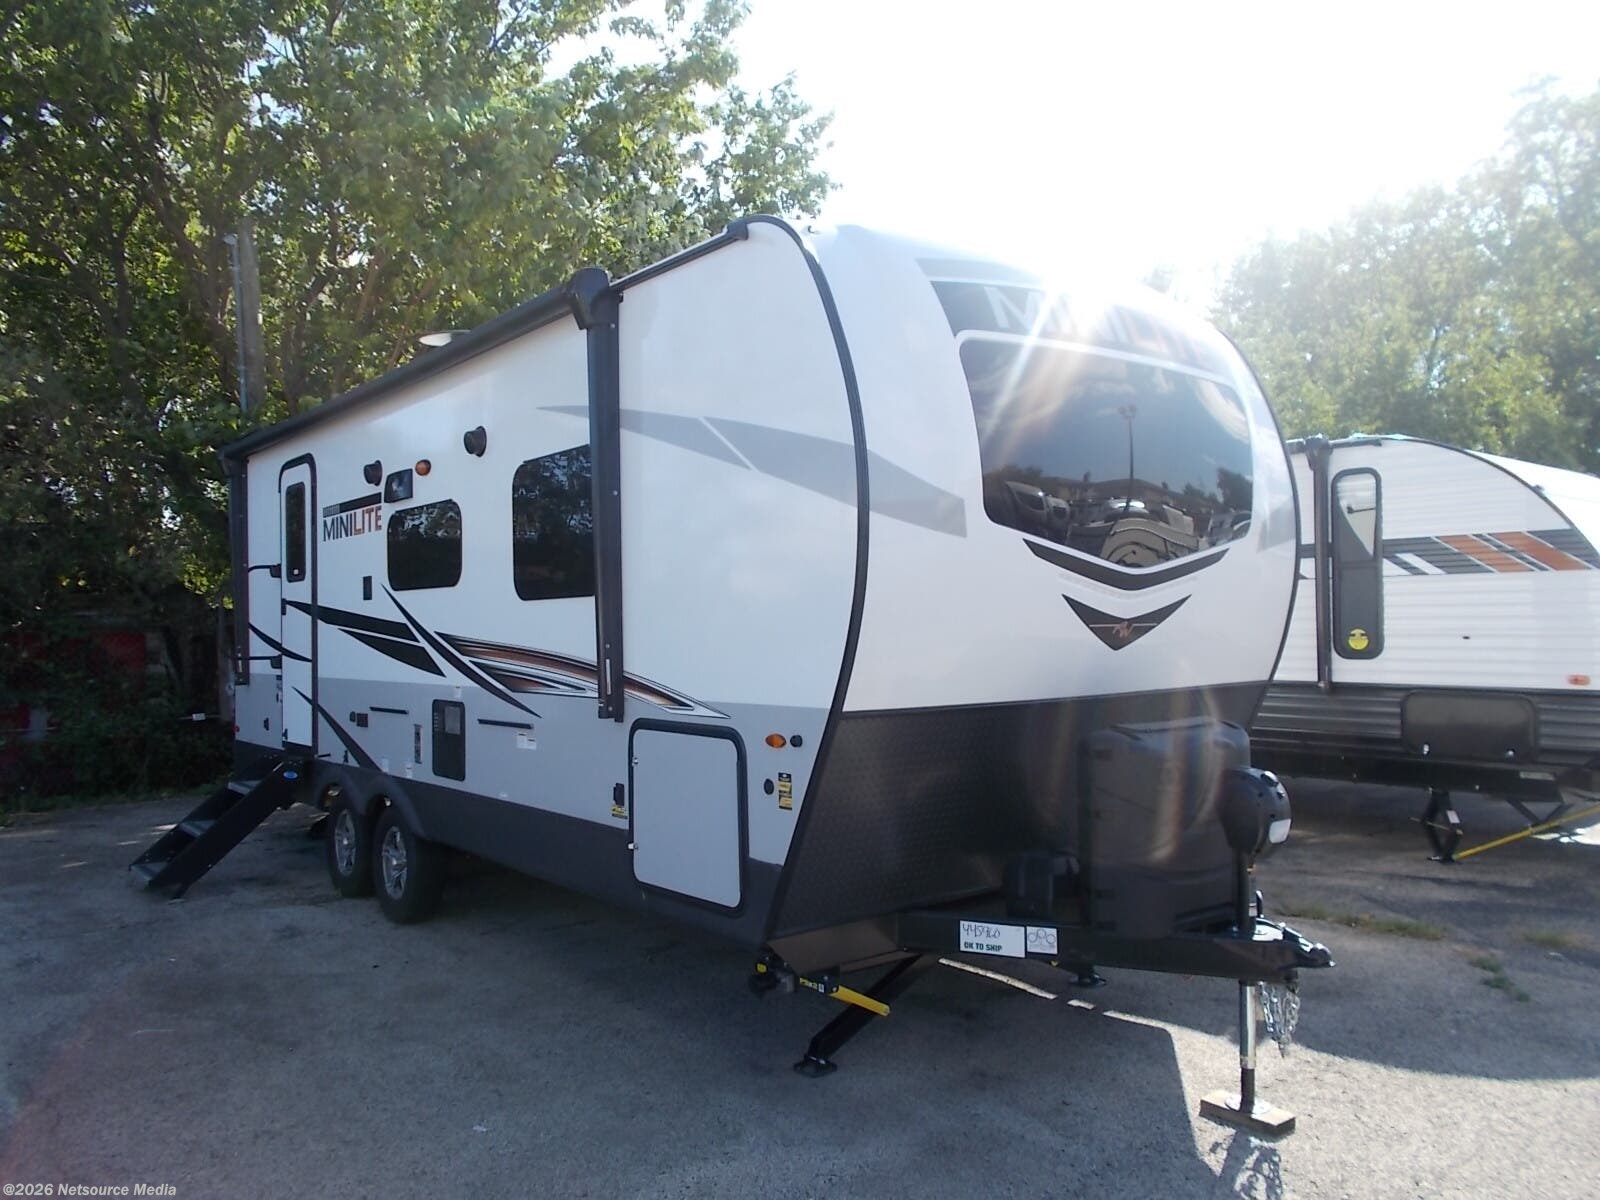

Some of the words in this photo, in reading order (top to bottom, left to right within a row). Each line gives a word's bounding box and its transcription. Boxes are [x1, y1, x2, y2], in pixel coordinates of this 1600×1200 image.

[323, 505, 382, 542] MINILITE
[963, 941, 974, 950] OK
[975, 942, 984, 951] TO
[986, 943, 1002, 952] SHIP
